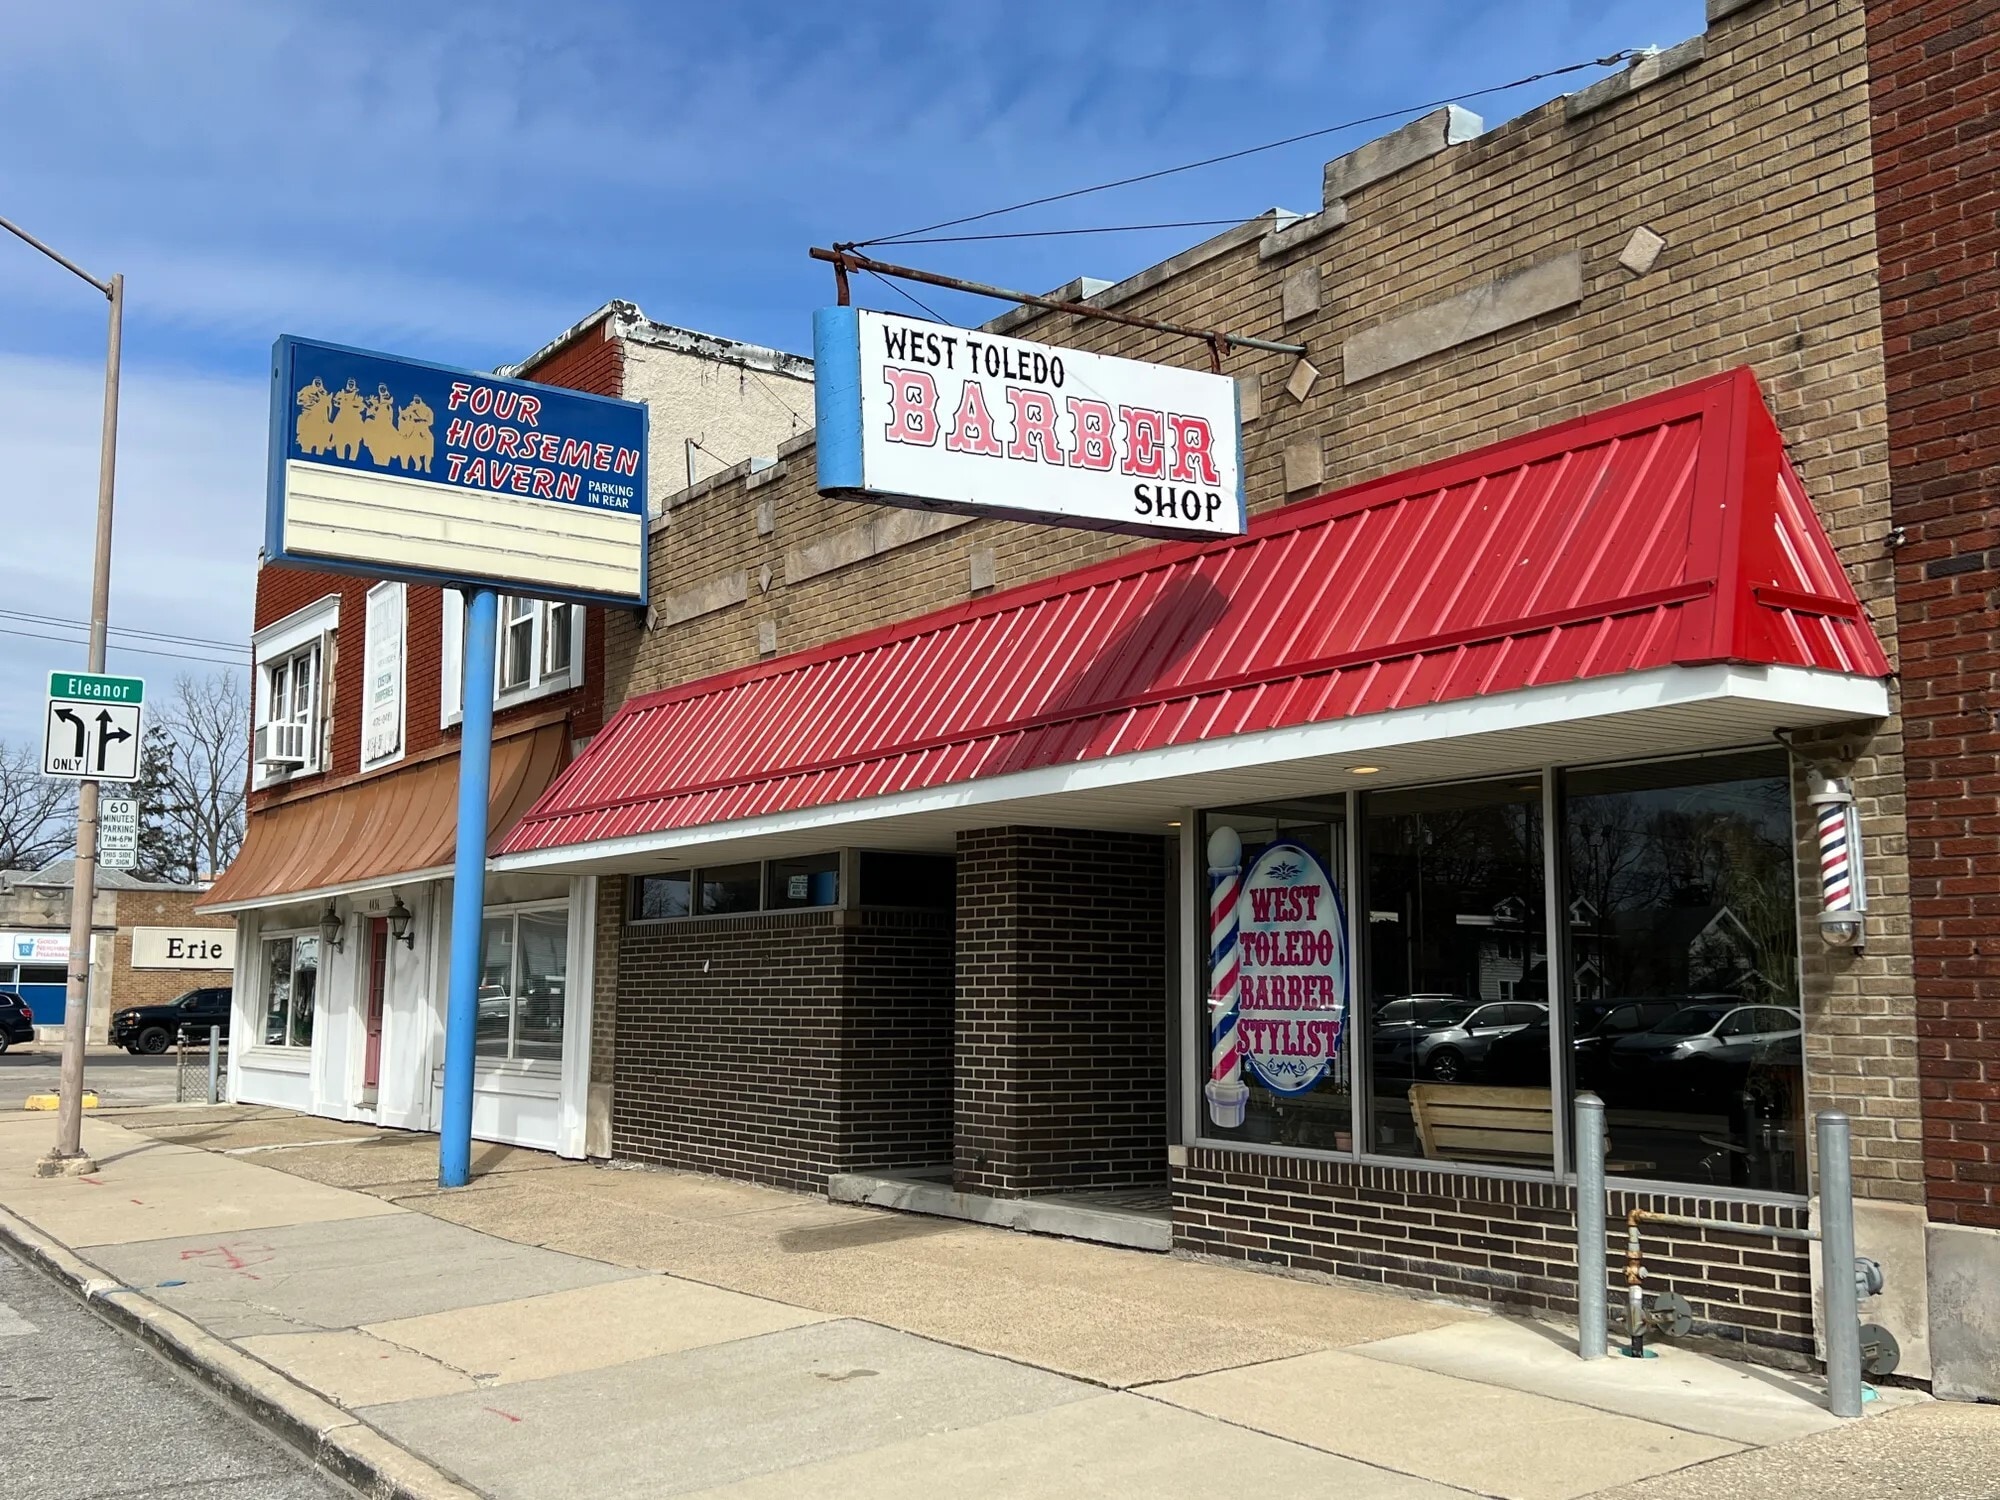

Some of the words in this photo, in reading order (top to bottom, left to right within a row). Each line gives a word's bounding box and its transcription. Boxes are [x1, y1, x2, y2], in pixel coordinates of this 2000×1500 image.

[882, 325, 957, 370] WEST
[966, 341, 1065, 388] TOLEDO
[448, 382, 541, 427] FOUR
[883, 365, 1220, 487] BARBER
[446, 418, 640, 476] HORSEMEN
[446, 453, 581, 501] TAVERN
[588, 480, 634, 497] PARKING
[588, 493, 599, 504] IN
[602, 494, 629, 509] REAR
[1134, 483, 1222, 522] SHOP
[68, 678, 130, 699] Eleanor
[53, 758, 82, 771] ONLY
[103, 814, 135, 824] MINUTES
[110, 802, 129, 813] 60
[103, 824, 134, 833] PARKING
[104, 835, 133, 843] 7AM-6PM
[1249, 885, 1321, 923] WEST
[166, 937, 222, 959] Erie
[1239, 929, 1335, 967] TOLEDO
[1239, 974, 1336, 1012] BARBER
[1235, 1018, 1340, 1059] STYLIST
